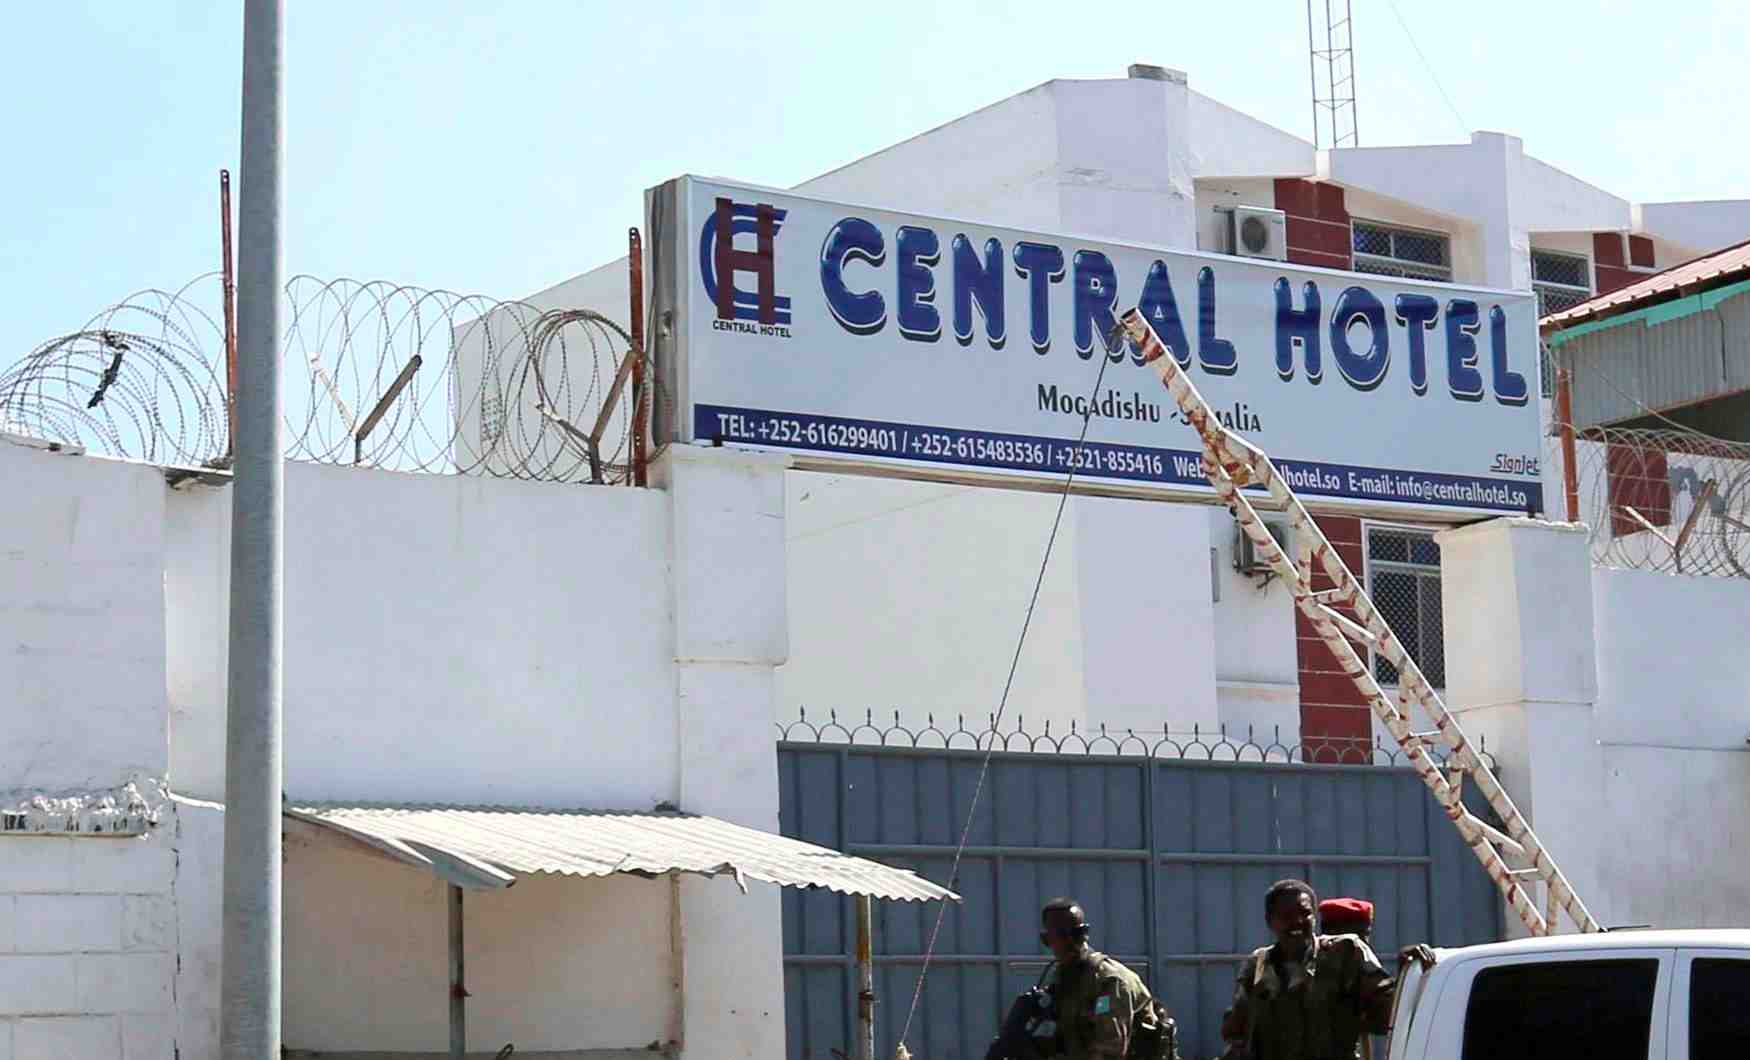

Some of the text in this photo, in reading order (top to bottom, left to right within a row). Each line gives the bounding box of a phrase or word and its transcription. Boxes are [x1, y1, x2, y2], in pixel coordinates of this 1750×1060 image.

[712, 319, 792, 338] CENTRAL HOTEL
[819, 217, 1528, 407] CENTRAL HOTEL
[717, 413, 755, 438] TEL:
[758, 418, 896, 451] +252-616299401
[911, 432, 1043, 464] +252-615483536
[1348, 471, 1394, 495] E-mail:
[1395, 475, 1527, 506] info@centralhotel.so
